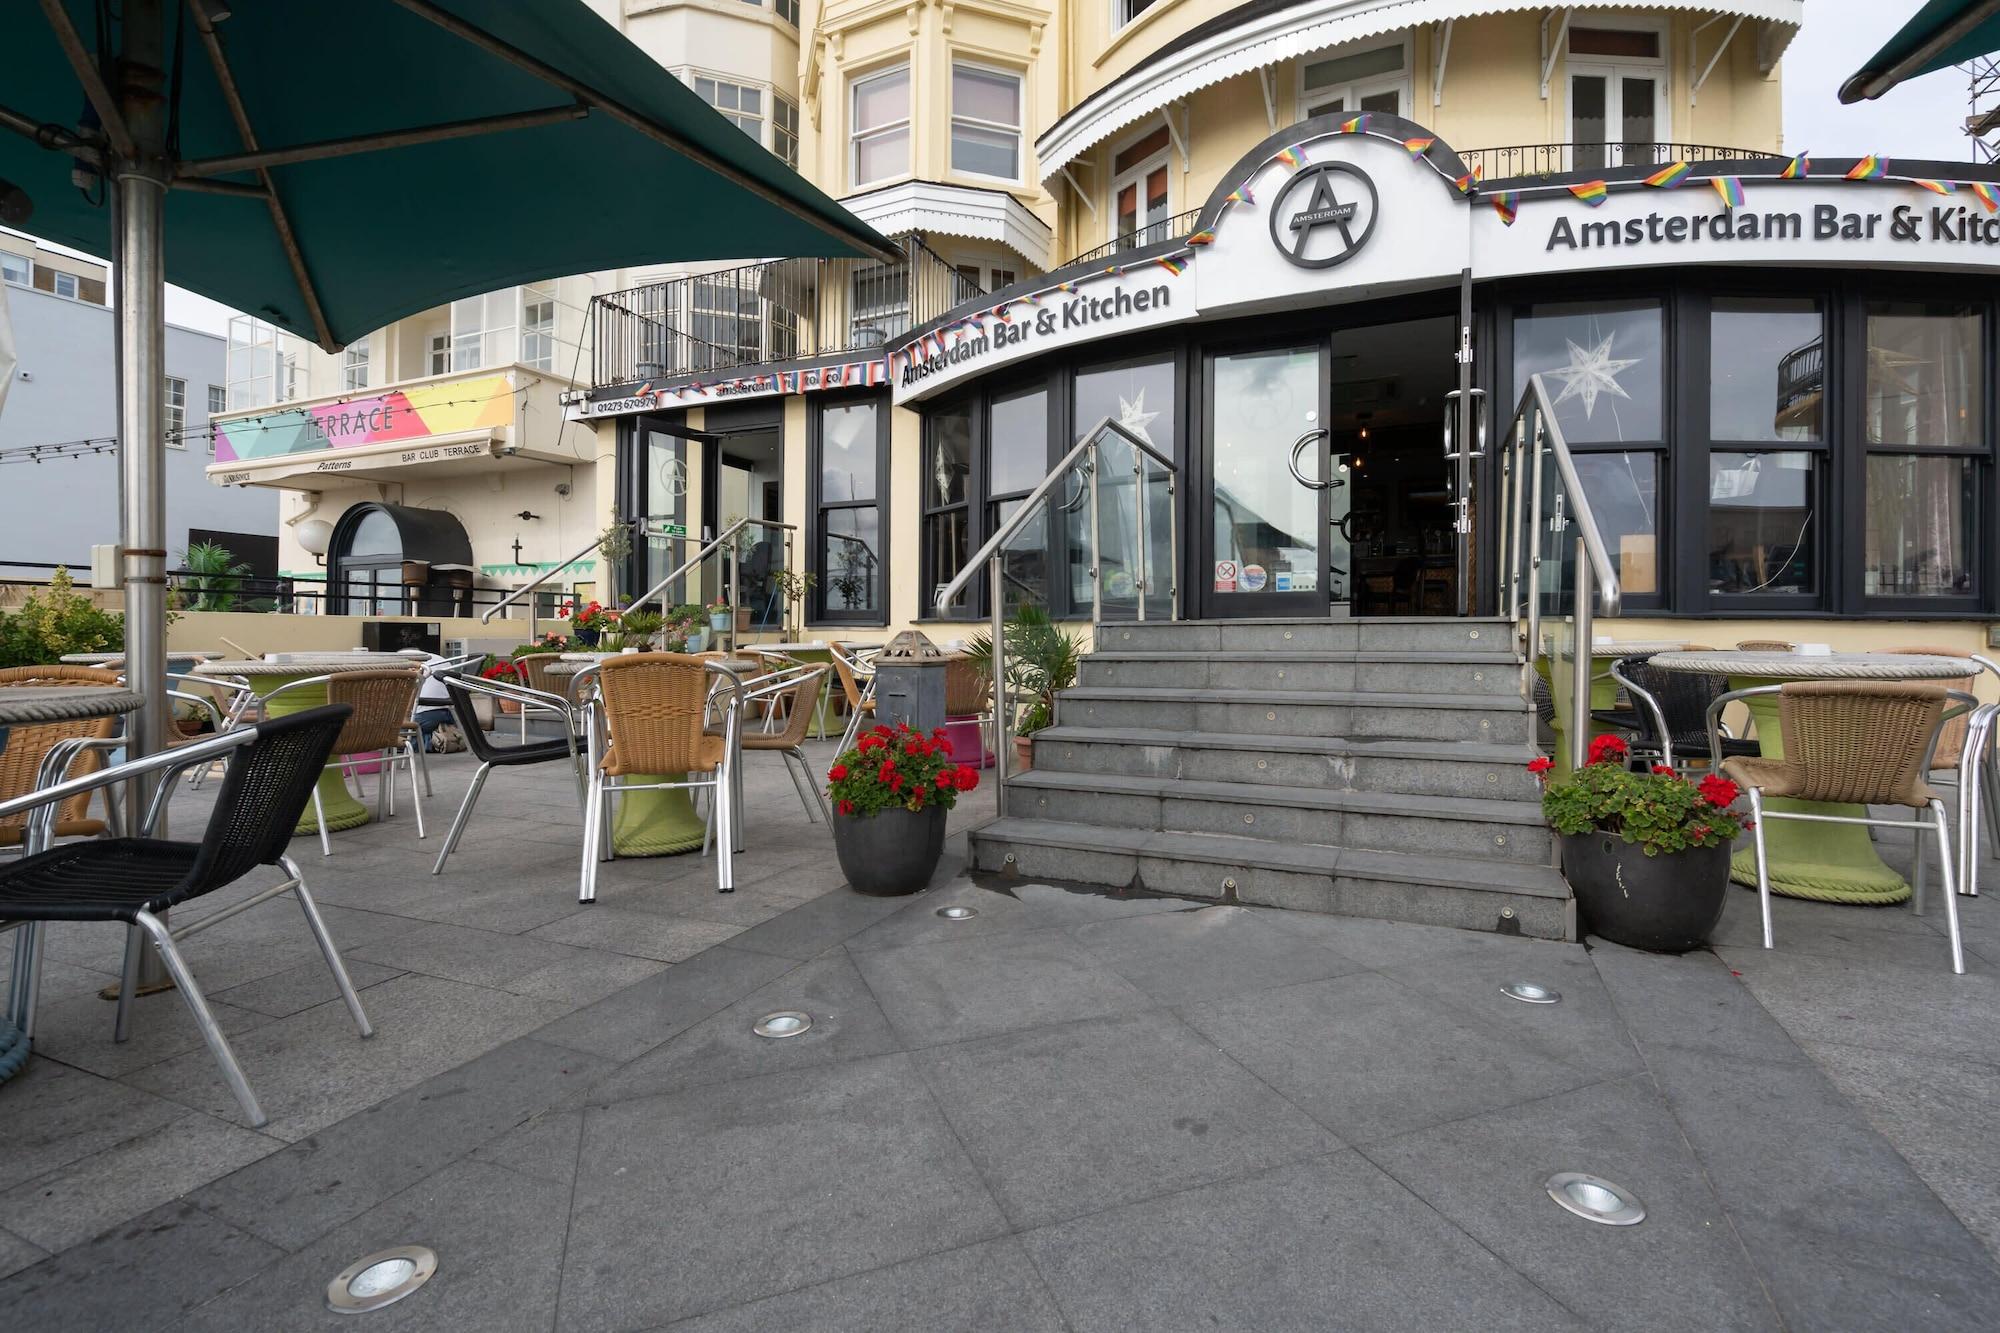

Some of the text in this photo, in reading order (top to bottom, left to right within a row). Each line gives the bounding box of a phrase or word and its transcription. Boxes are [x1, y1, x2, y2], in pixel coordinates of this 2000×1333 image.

[1293, 207, 1351, 223] AMSTERDAM
[1546, 206, 1802, 251] Amsterdam
[1814, 204, 1881, 240] Bar
[1890, 206, 1922, 241] &
[901, 284, 1170, 389] Amsterdam Bar & Kitchen
[597, 401, 623, 412] 01273
[305, 406, 393, 441] TERRACE
[402, 444, 481, 463] BAR CLUB TERRACE
[317, 461, 352, 471] Patterns
